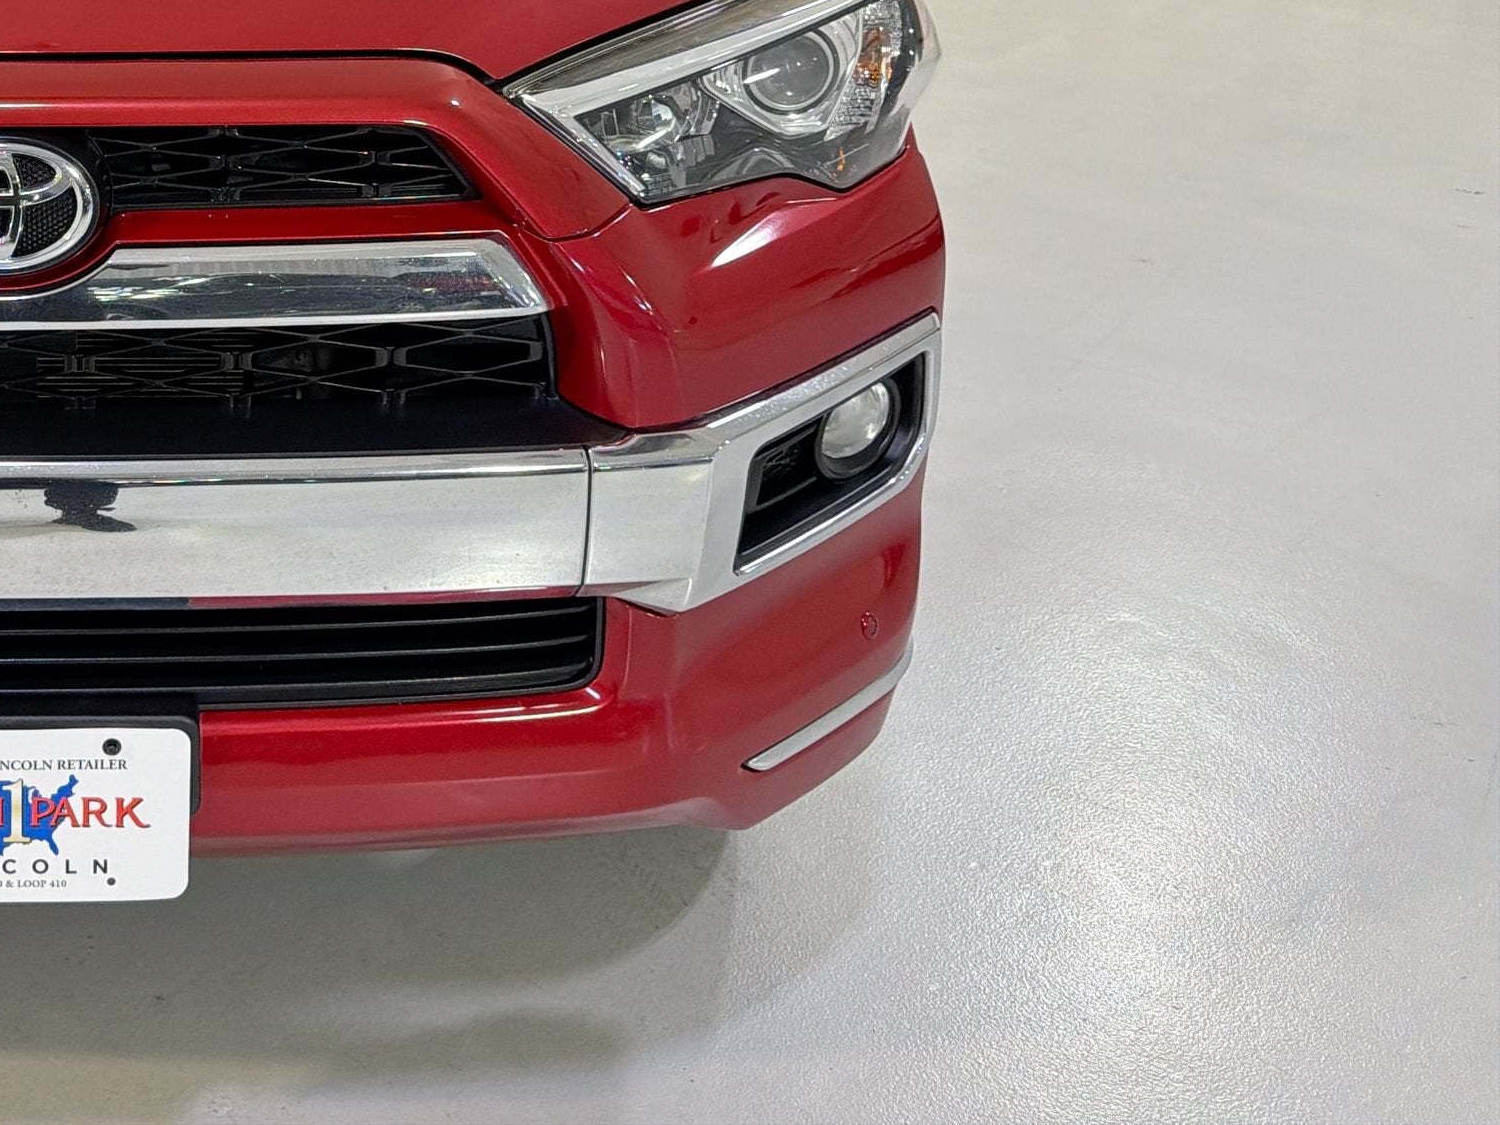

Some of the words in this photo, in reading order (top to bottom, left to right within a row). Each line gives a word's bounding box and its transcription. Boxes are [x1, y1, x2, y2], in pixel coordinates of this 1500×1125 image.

[57, 759, 128, 770] RETAILER
[31, 797, 151, 828] PARK
[6, 880, 14, 888] &
[17, 880, 47, 888] LOOP
